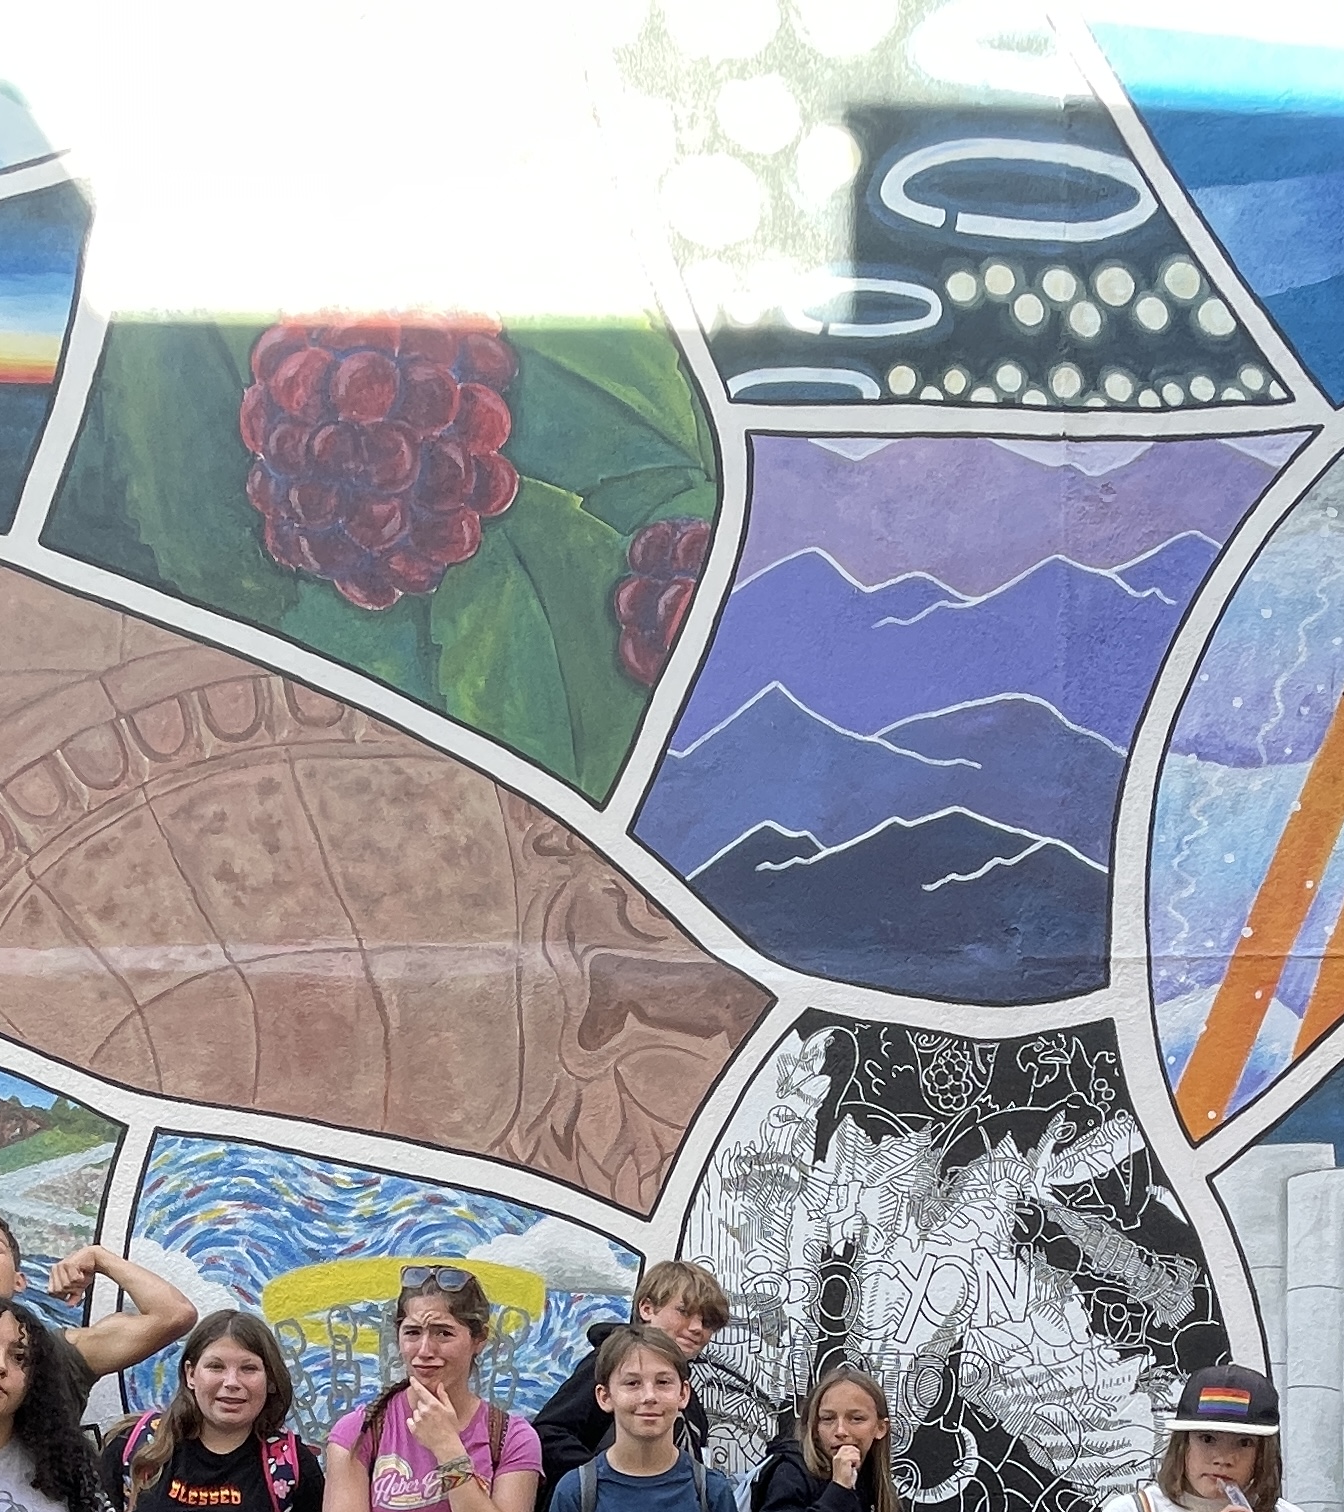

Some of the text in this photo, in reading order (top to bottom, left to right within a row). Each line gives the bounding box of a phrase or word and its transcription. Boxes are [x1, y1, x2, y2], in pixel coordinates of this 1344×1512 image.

[741, 1243, 1033, 1354] PROCYON
[168, 1479, 242, 1506] BLESSED
[373, 1472, 420, 1507] Heber
